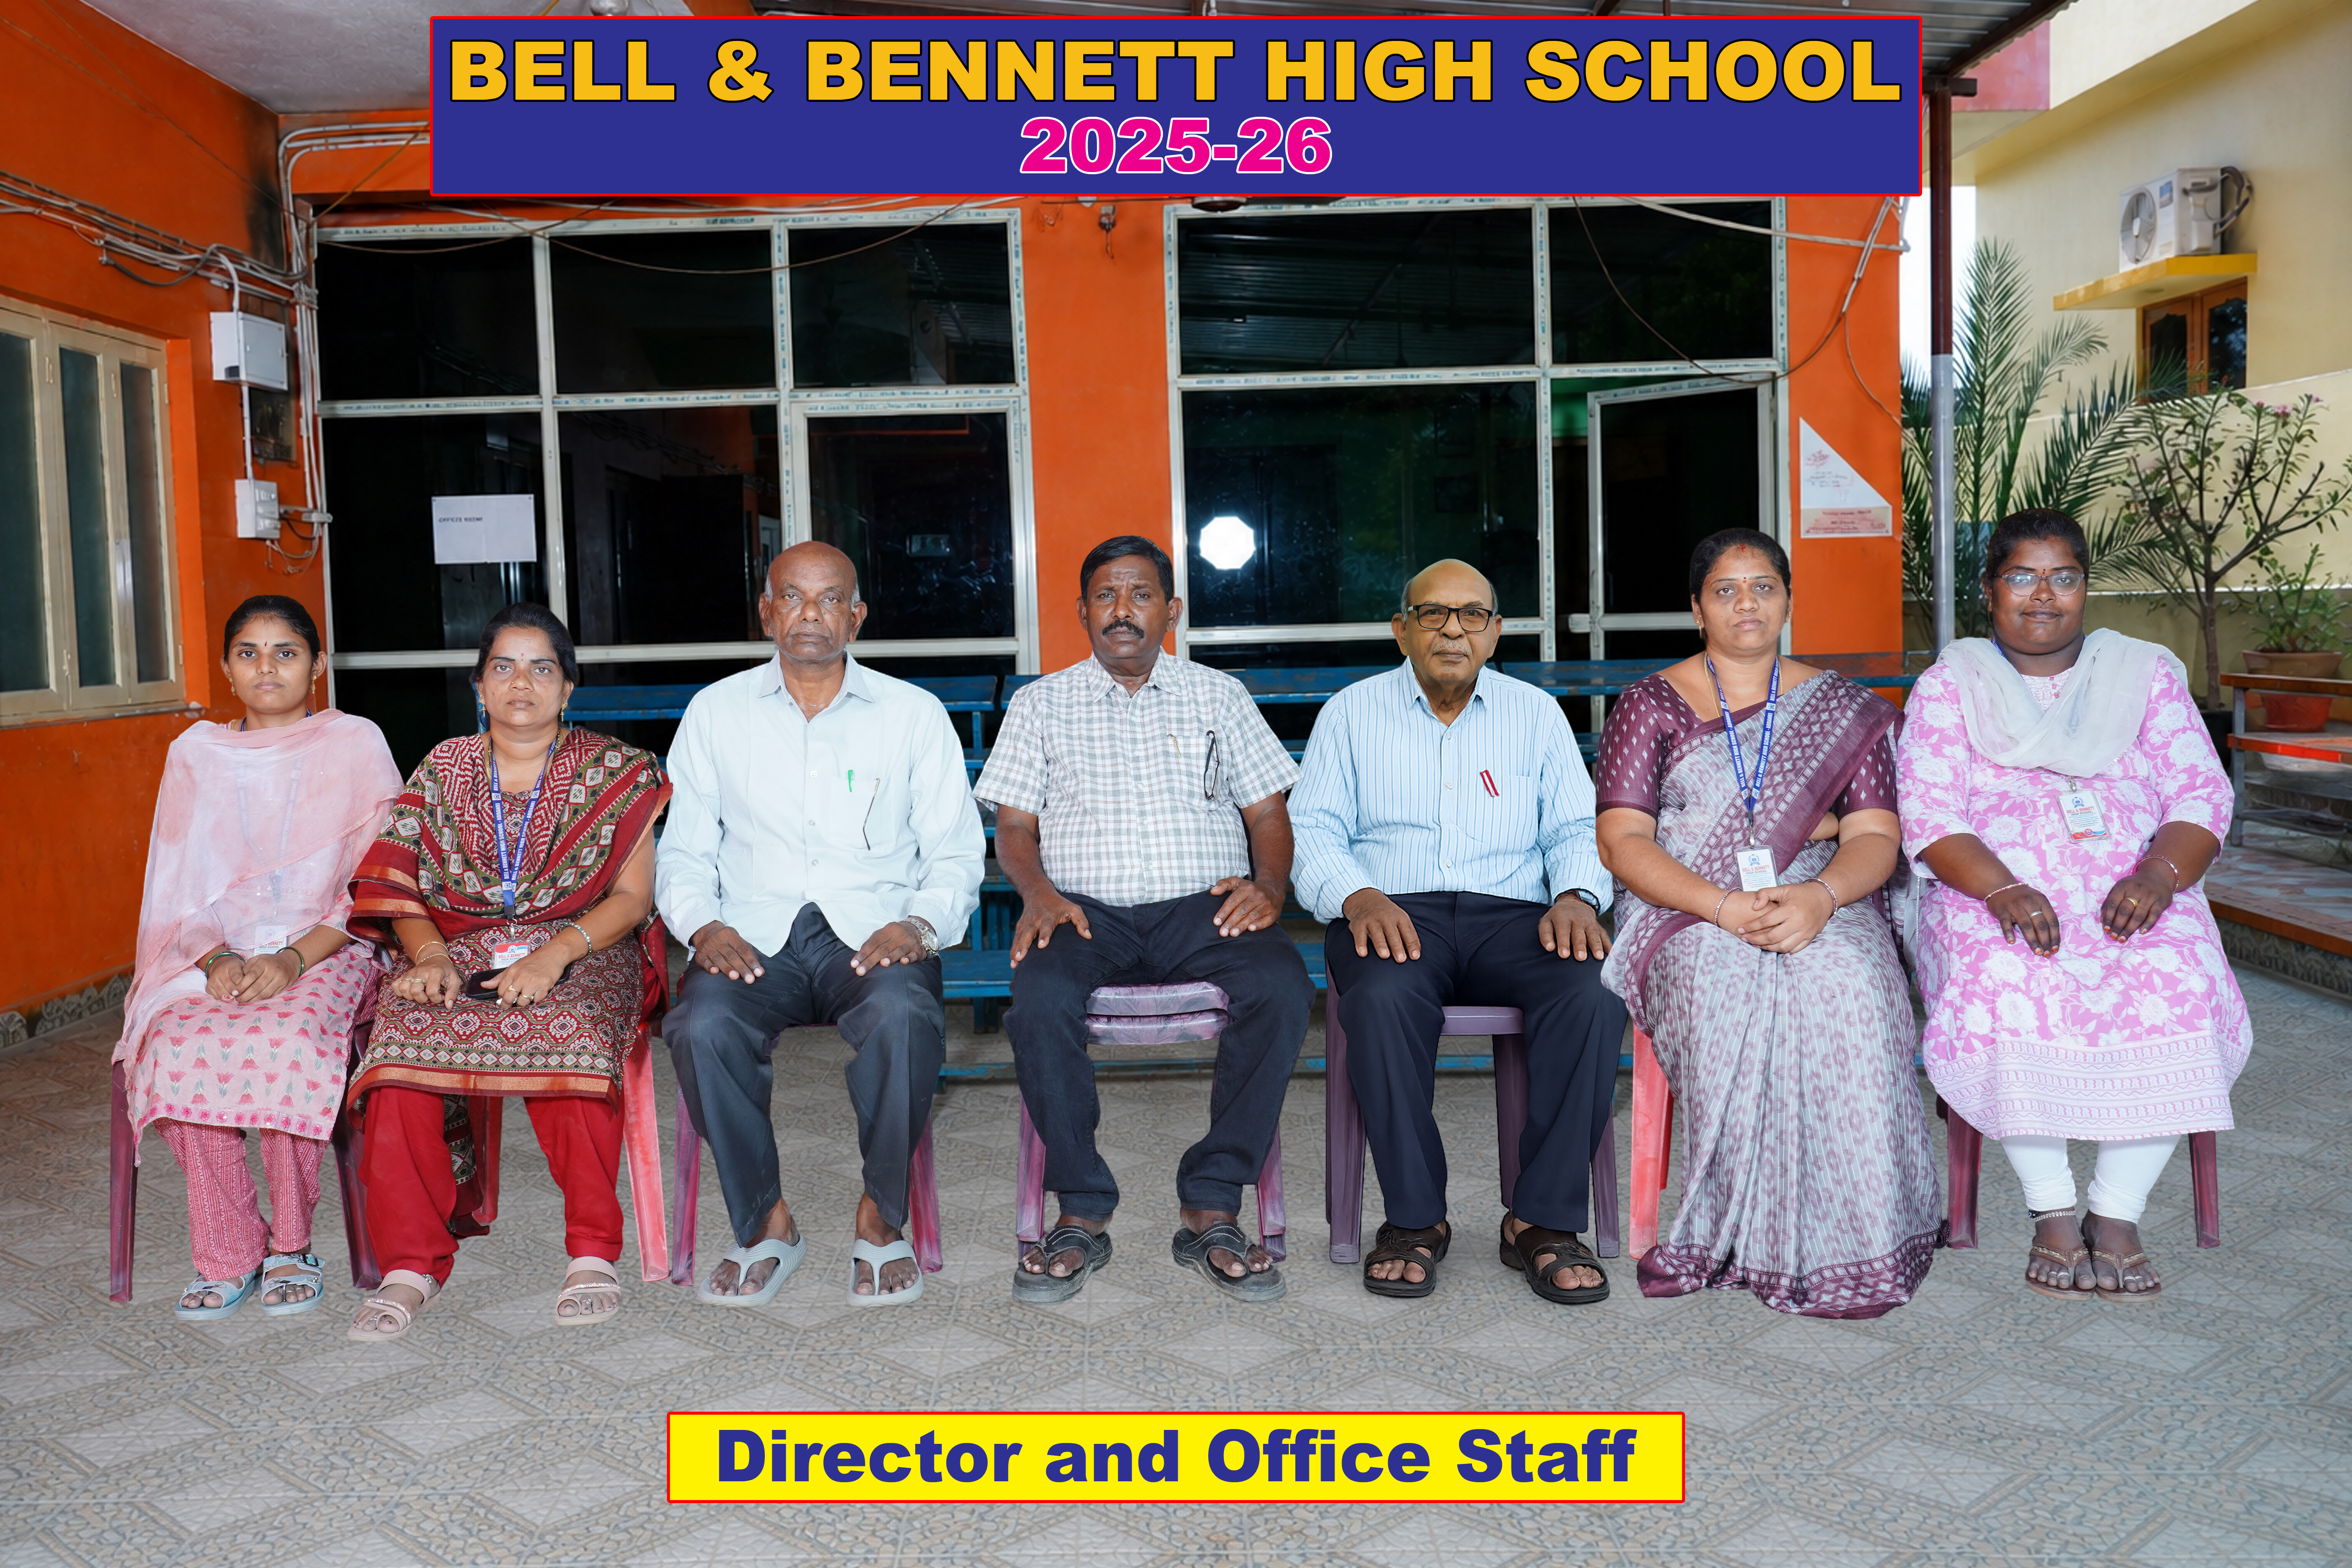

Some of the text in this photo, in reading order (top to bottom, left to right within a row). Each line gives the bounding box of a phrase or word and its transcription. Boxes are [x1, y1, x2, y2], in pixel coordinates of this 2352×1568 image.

[1724, 711, 1733, 728] ADDANKI
[1758, 755, 1767, 774] BENNETT
[527, 801, 535, 818] ADDANKI
